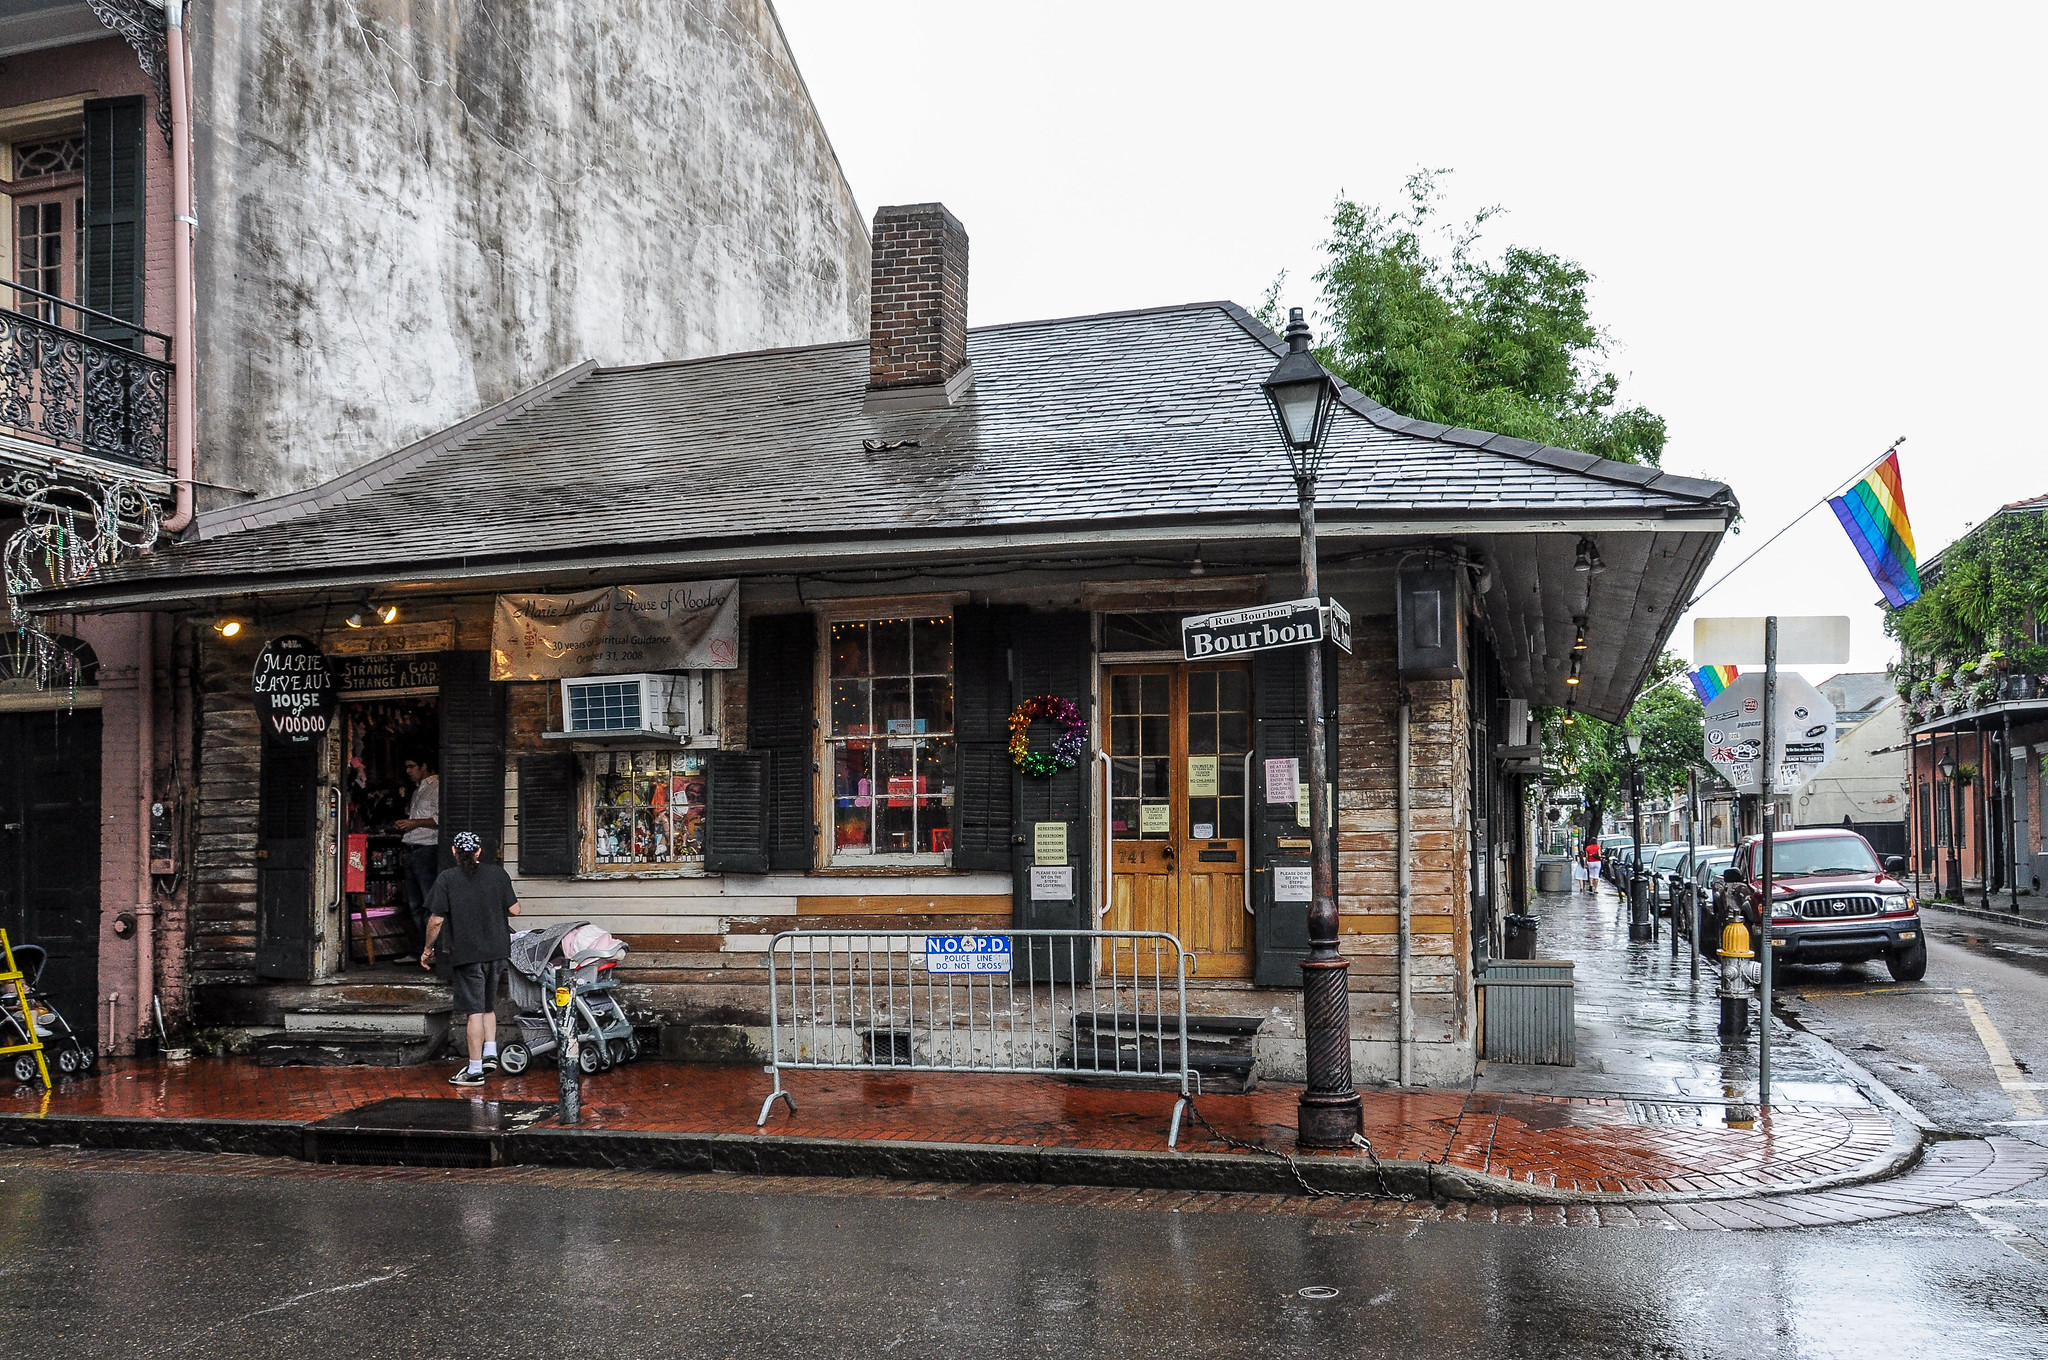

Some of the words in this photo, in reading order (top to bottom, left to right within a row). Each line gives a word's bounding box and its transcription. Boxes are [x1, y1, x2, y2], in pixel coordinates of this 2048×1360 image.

[512, 600, 557, 619] Marie
[614, 593, 656, 612] House
[660, 589, 672, 617] of
[675, 586, 725, 608] Voodoo
[1215, 618, 1235, 626] Rue
[1241, 608, 1287, 621] Bourbon
[553, 641, 562, 650] 30
[565, 640, 586, 650] years
[631, 636, 671, 645] Guidance
[1192, 623, 1314, 656] Bourbon
[264, 654, 323, 673] MARIE
[606, 652, 618, 662] 31,
[622, 651, 643, 660] 2008
[341, 663, 396, 676] STRANGE
[254, 670, 331, 692] LAVEAU'S
[342, 676, 396, 689] STRANGE
[271, 693, 320, 708] HOUSE
[292, 705, 305, 717] of
[272, 716, 326, 734] VOODOO
[1118, 850, 1145, 863] 741
